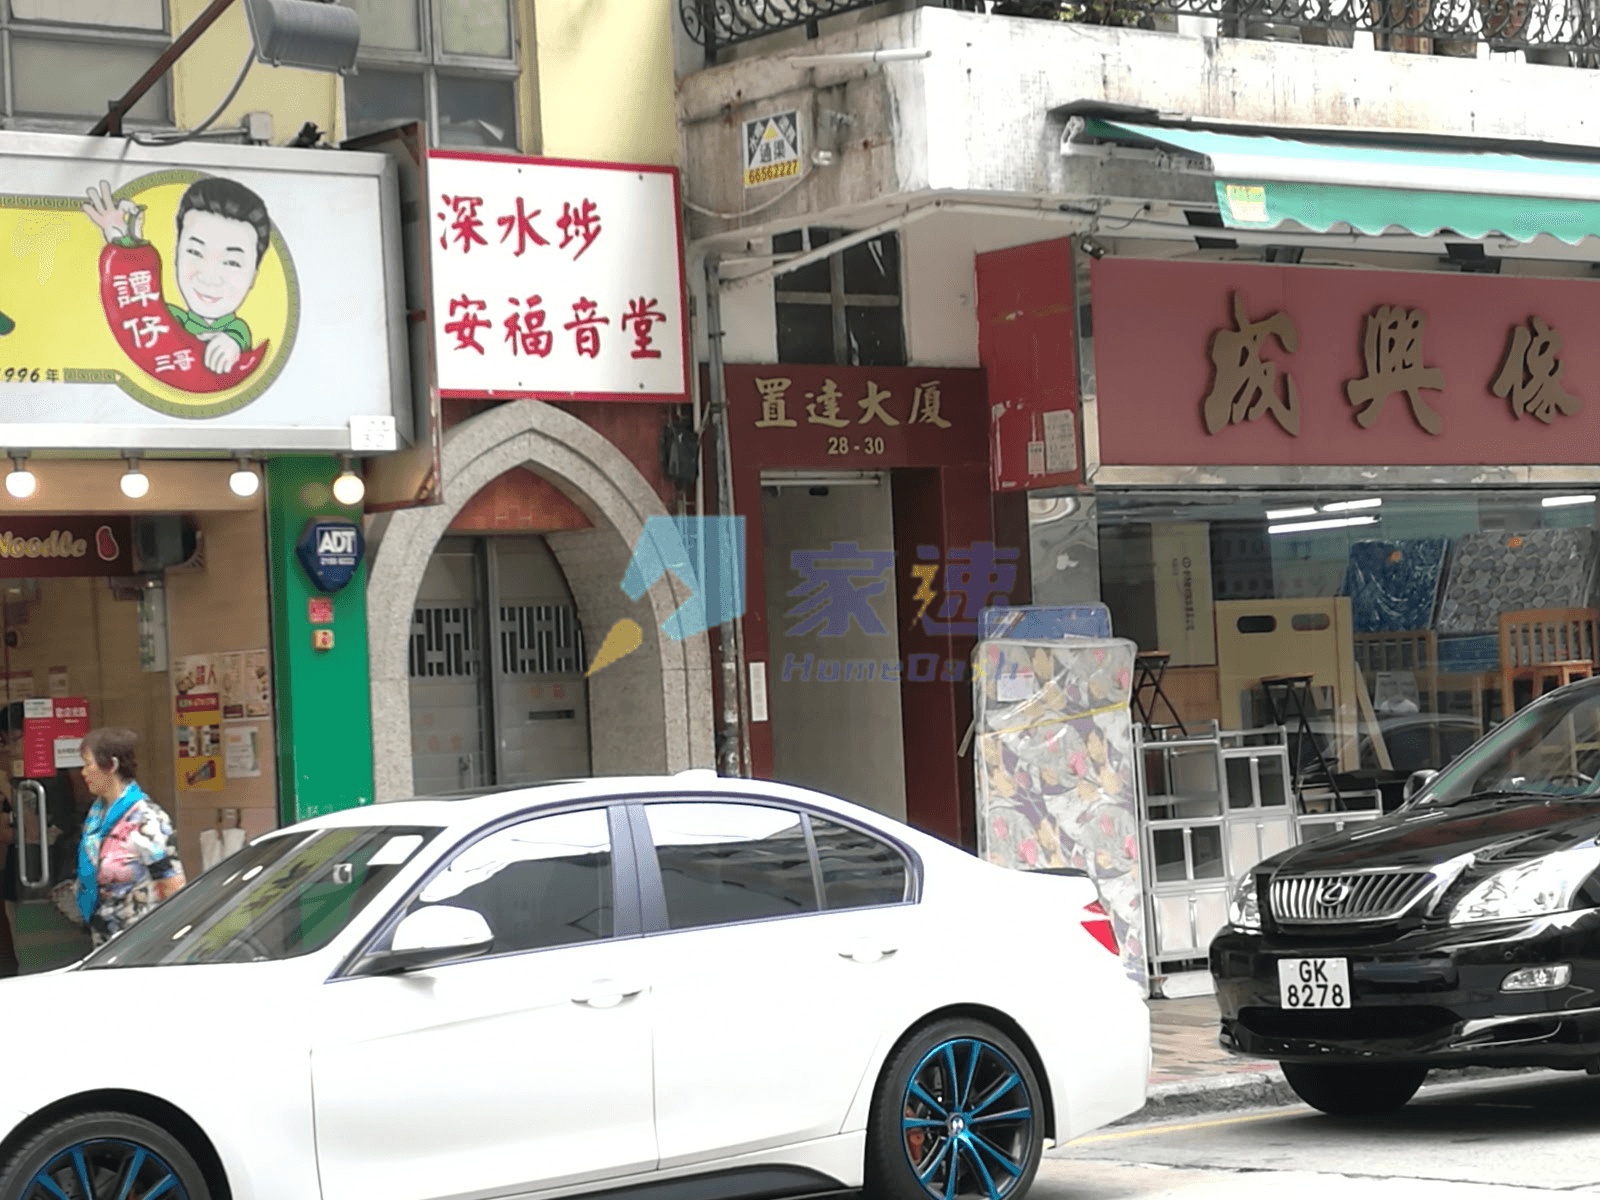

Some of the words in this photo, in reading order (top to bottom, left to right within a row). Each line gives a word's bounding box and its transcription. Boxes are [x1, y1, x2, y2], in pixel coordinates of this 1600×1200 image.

[437, 193, 602, 262] 深水埗
[113, 270, 170, 348] 譚仔
[444, 292, 667, 359] 安福音堂
[154, 349, 196, 373] 三哥
[318, 531, 356, 553] ADT
[1299, 960, 1327, 982] GK
[1287, 984, 1344, 1007] 8278
